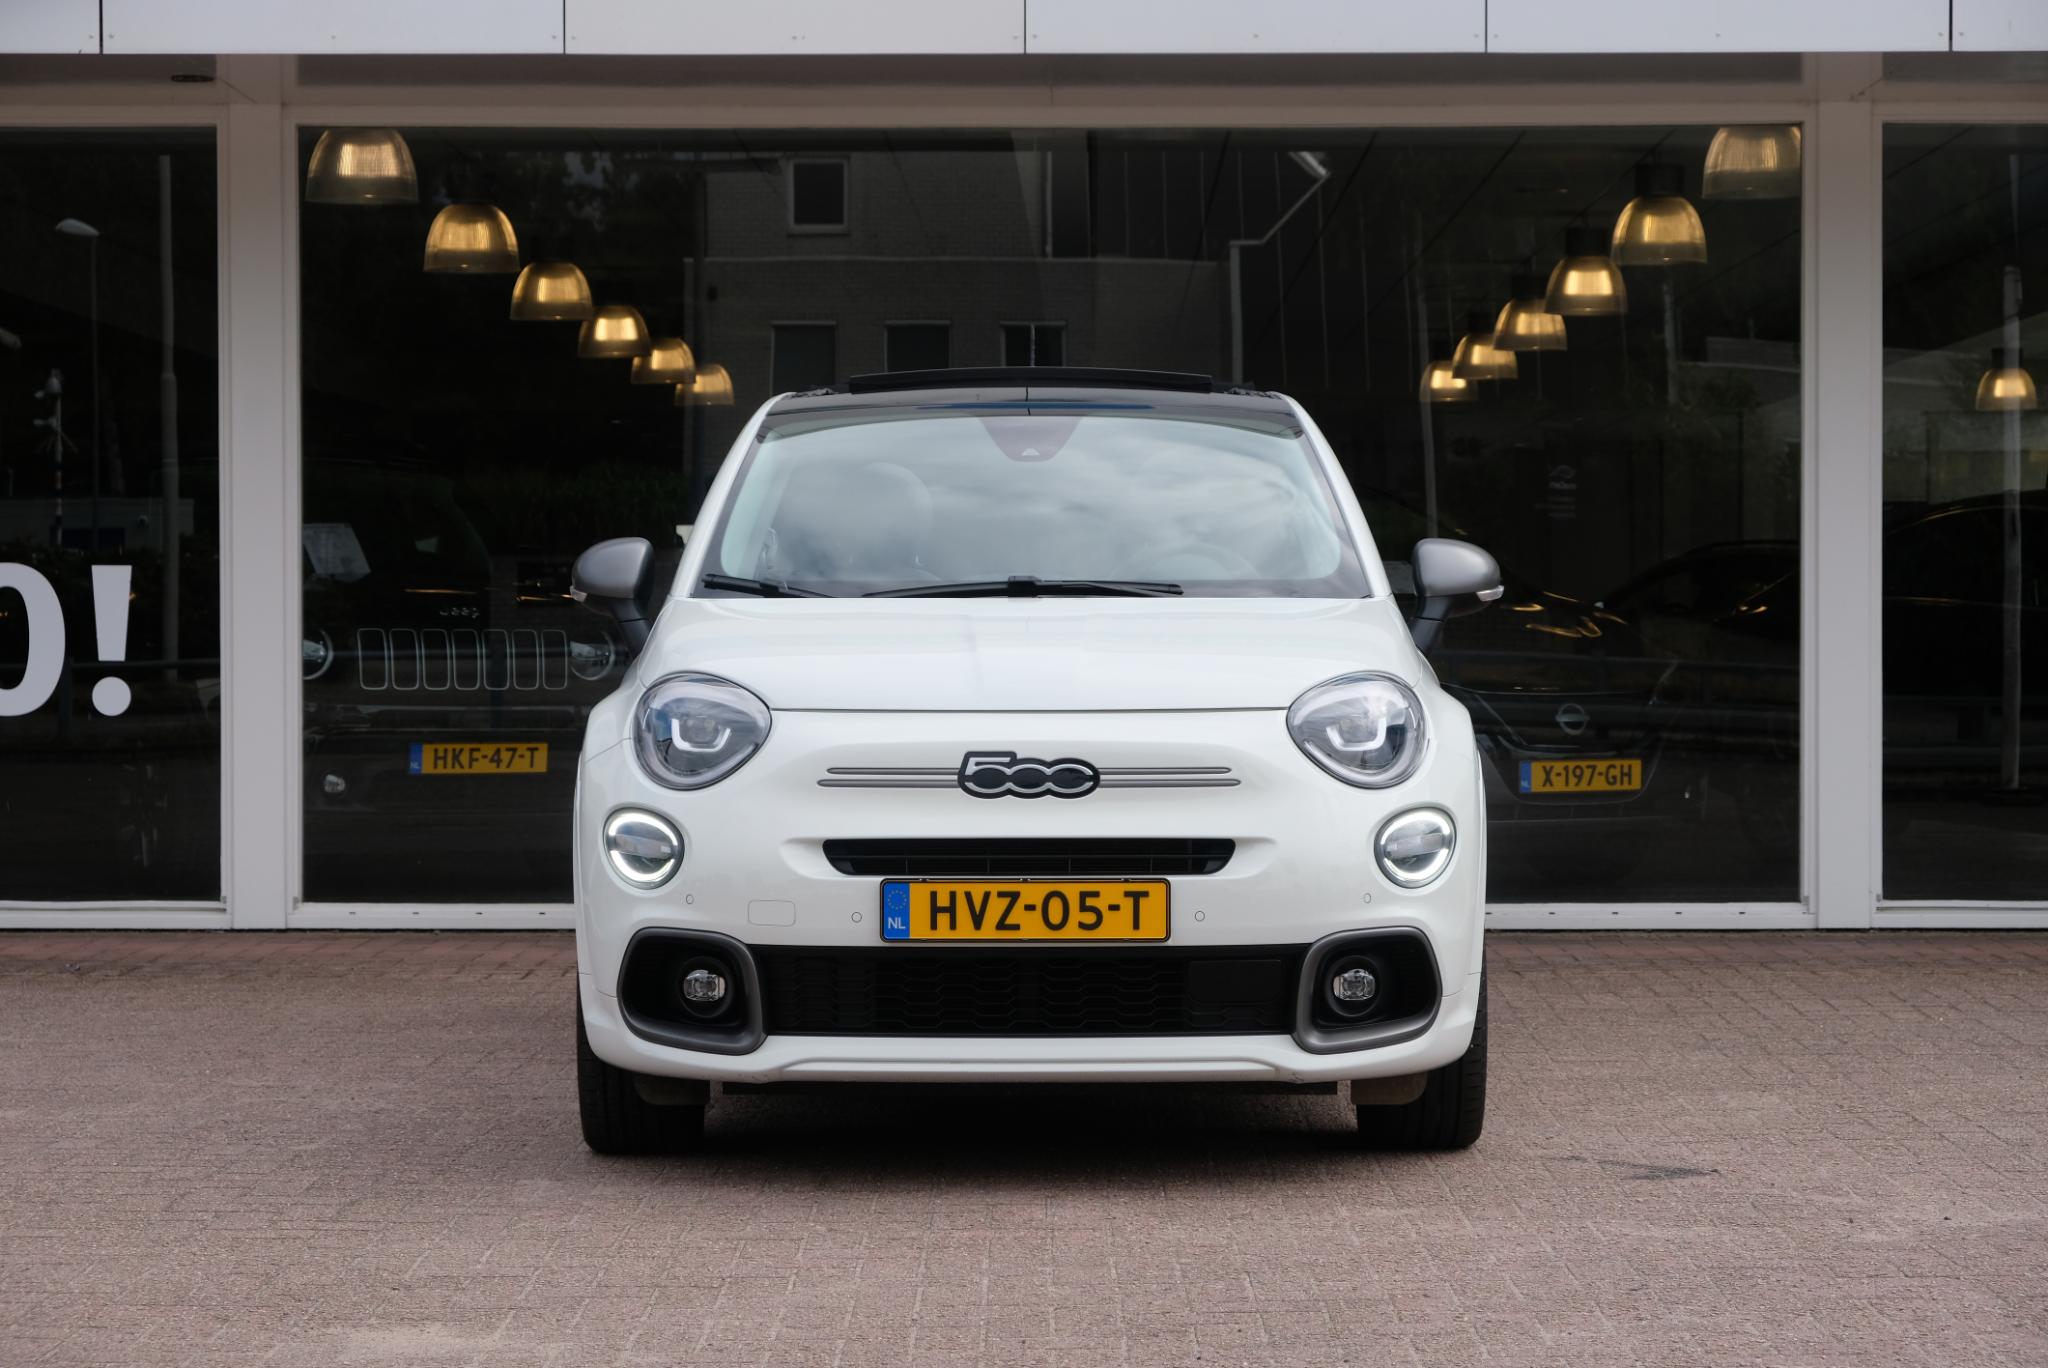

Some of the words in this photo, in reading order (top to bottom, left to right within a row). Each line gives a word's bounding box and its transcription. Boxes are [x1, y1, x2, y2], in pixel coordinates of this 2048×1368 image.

[433, 747, 539, 770] HKF-47-T
[963, 755, 1096, 796] 500
[1541, 763, 1633, 788] X-197-GH
[929, 889, 1150, 931] HVZ-05-T
[887, 917, 906, 929] NL
